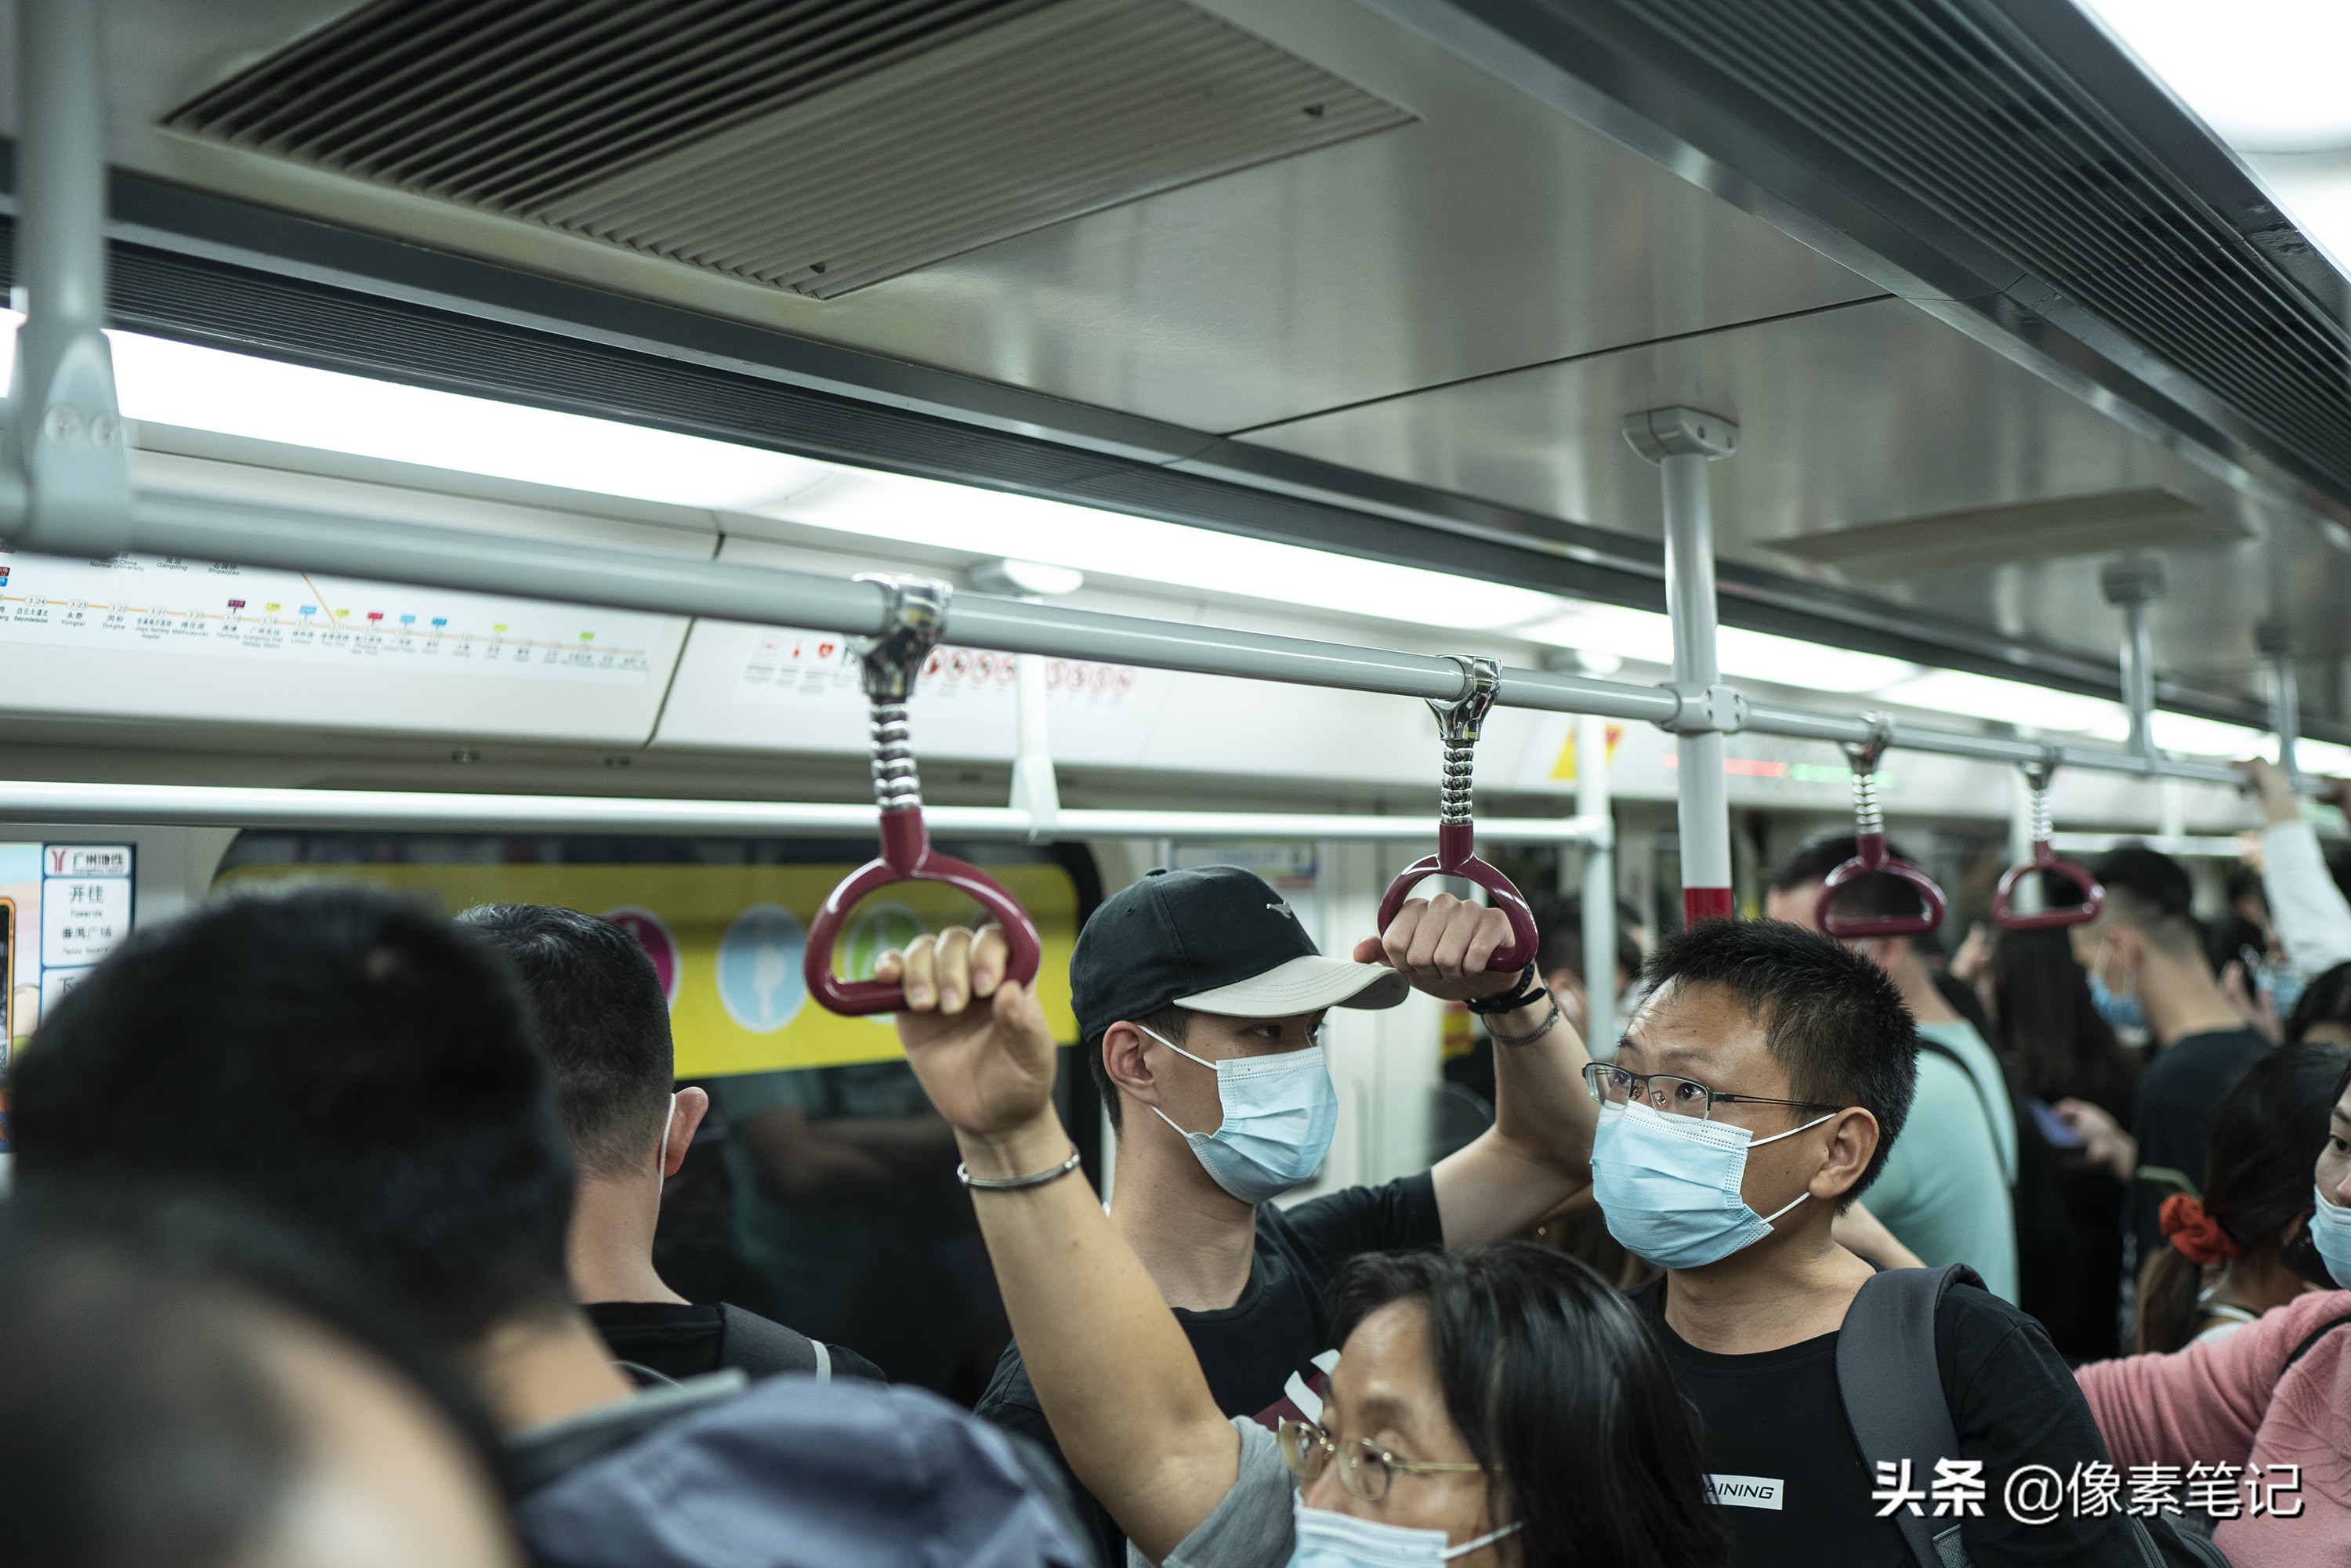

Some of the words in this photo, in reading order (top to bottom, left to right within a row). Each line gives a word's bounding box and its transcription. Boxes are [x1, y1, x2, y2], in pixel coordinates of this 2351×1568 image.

[89, 560, 113, 569] Normal
[113, 563, 145, 572] University
[156, 561, 188, 571] Gangding
[207, 567, 240, 576] Shipaiqiao
[70, 884, 104, 904] 开往
